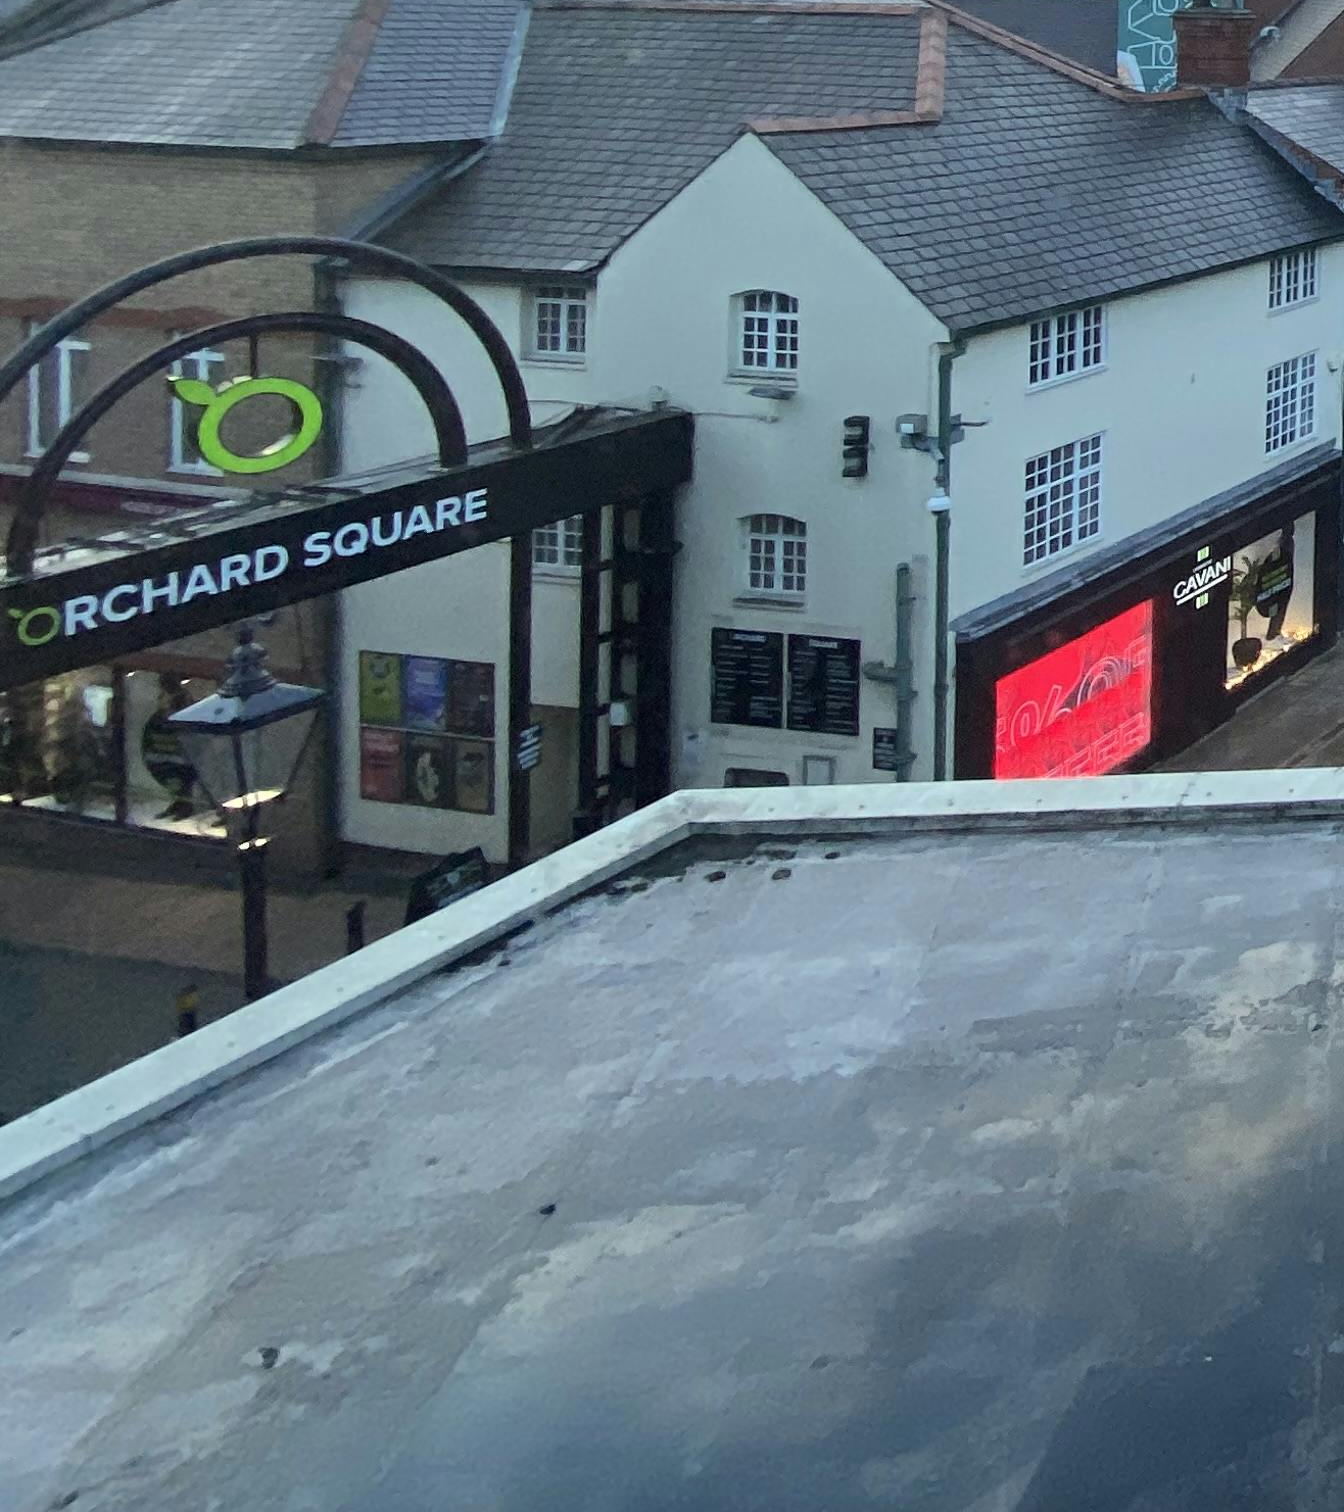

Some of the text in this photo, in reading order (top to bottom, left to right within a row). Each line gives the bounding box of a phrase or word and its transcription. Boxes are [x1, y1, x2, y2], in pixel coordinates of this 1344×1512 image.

[12, 487, 489, 646] ORCHARD SQUARE
[1173, 555, 1232, 599] CAVANI
